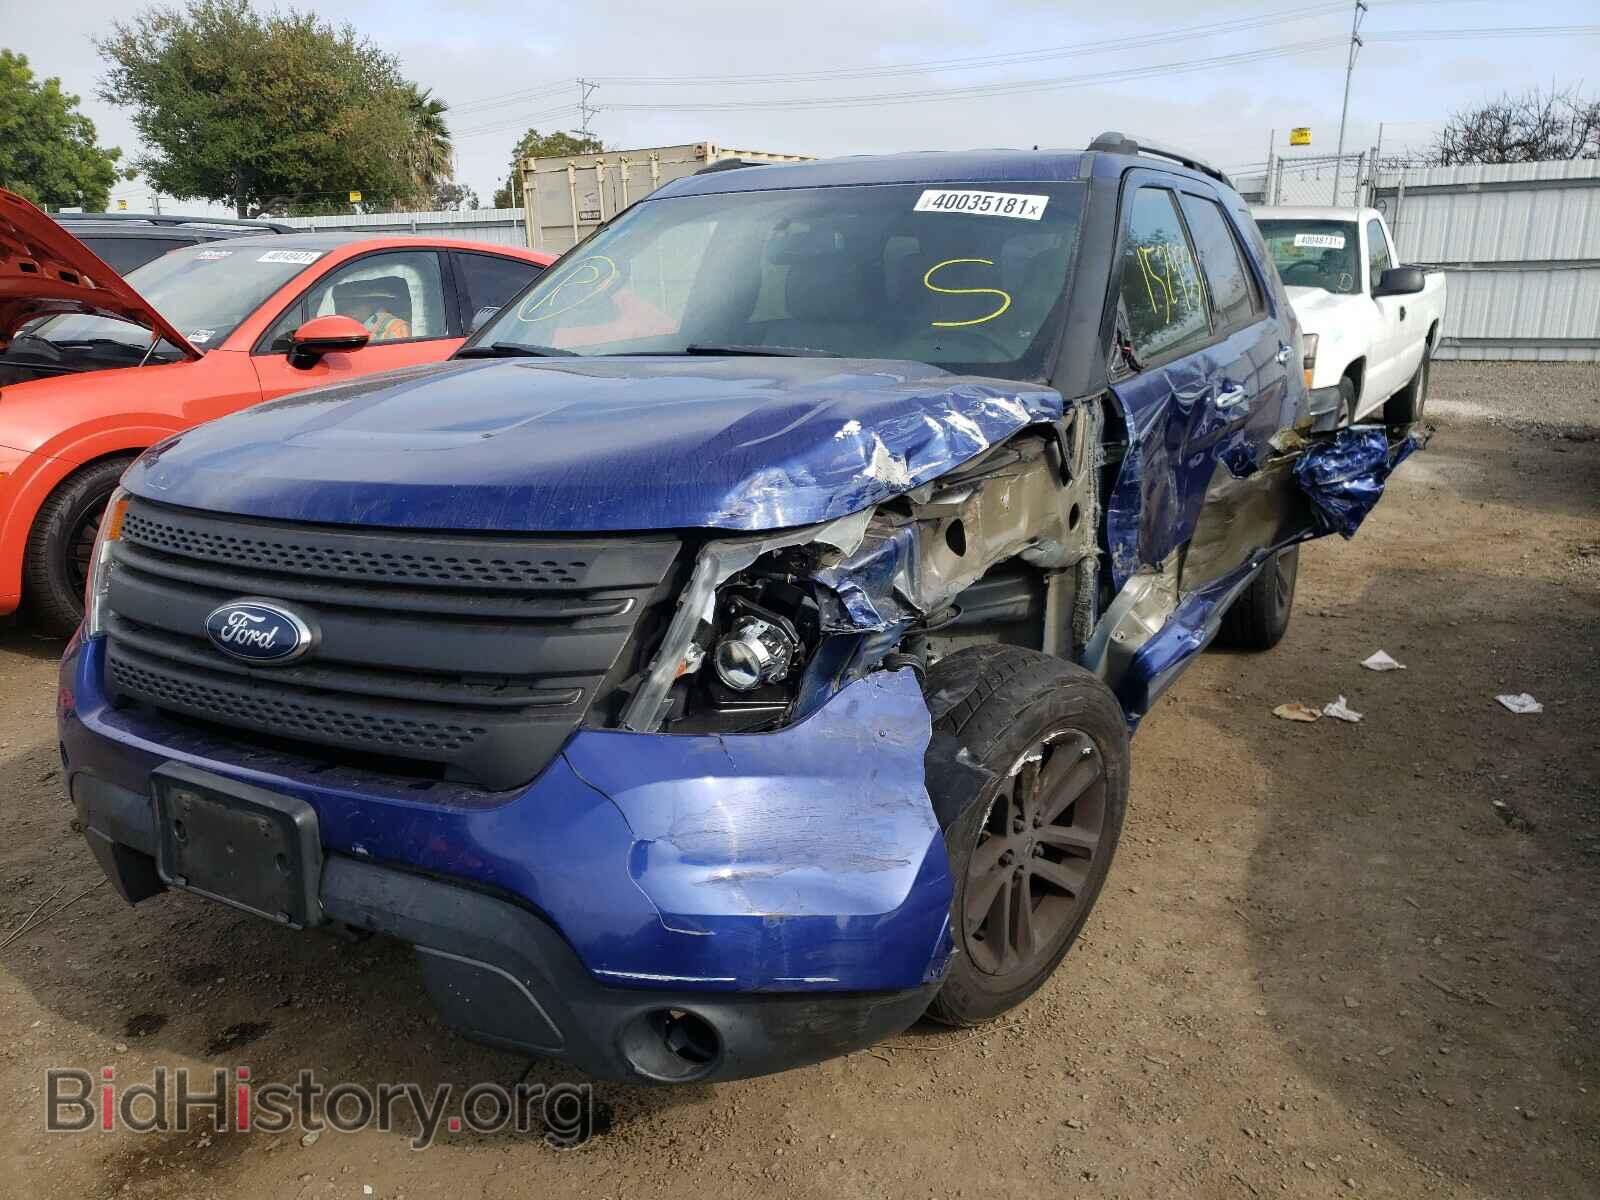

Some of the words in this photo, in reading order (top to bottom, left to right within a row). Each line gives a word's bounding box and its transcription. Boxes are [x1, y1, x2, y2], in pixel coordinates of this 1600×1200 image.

[931, 192, 1028, 215] 40035181
[924, 258, 1012, 328] S
[220, 611, 279, 650] Ford
